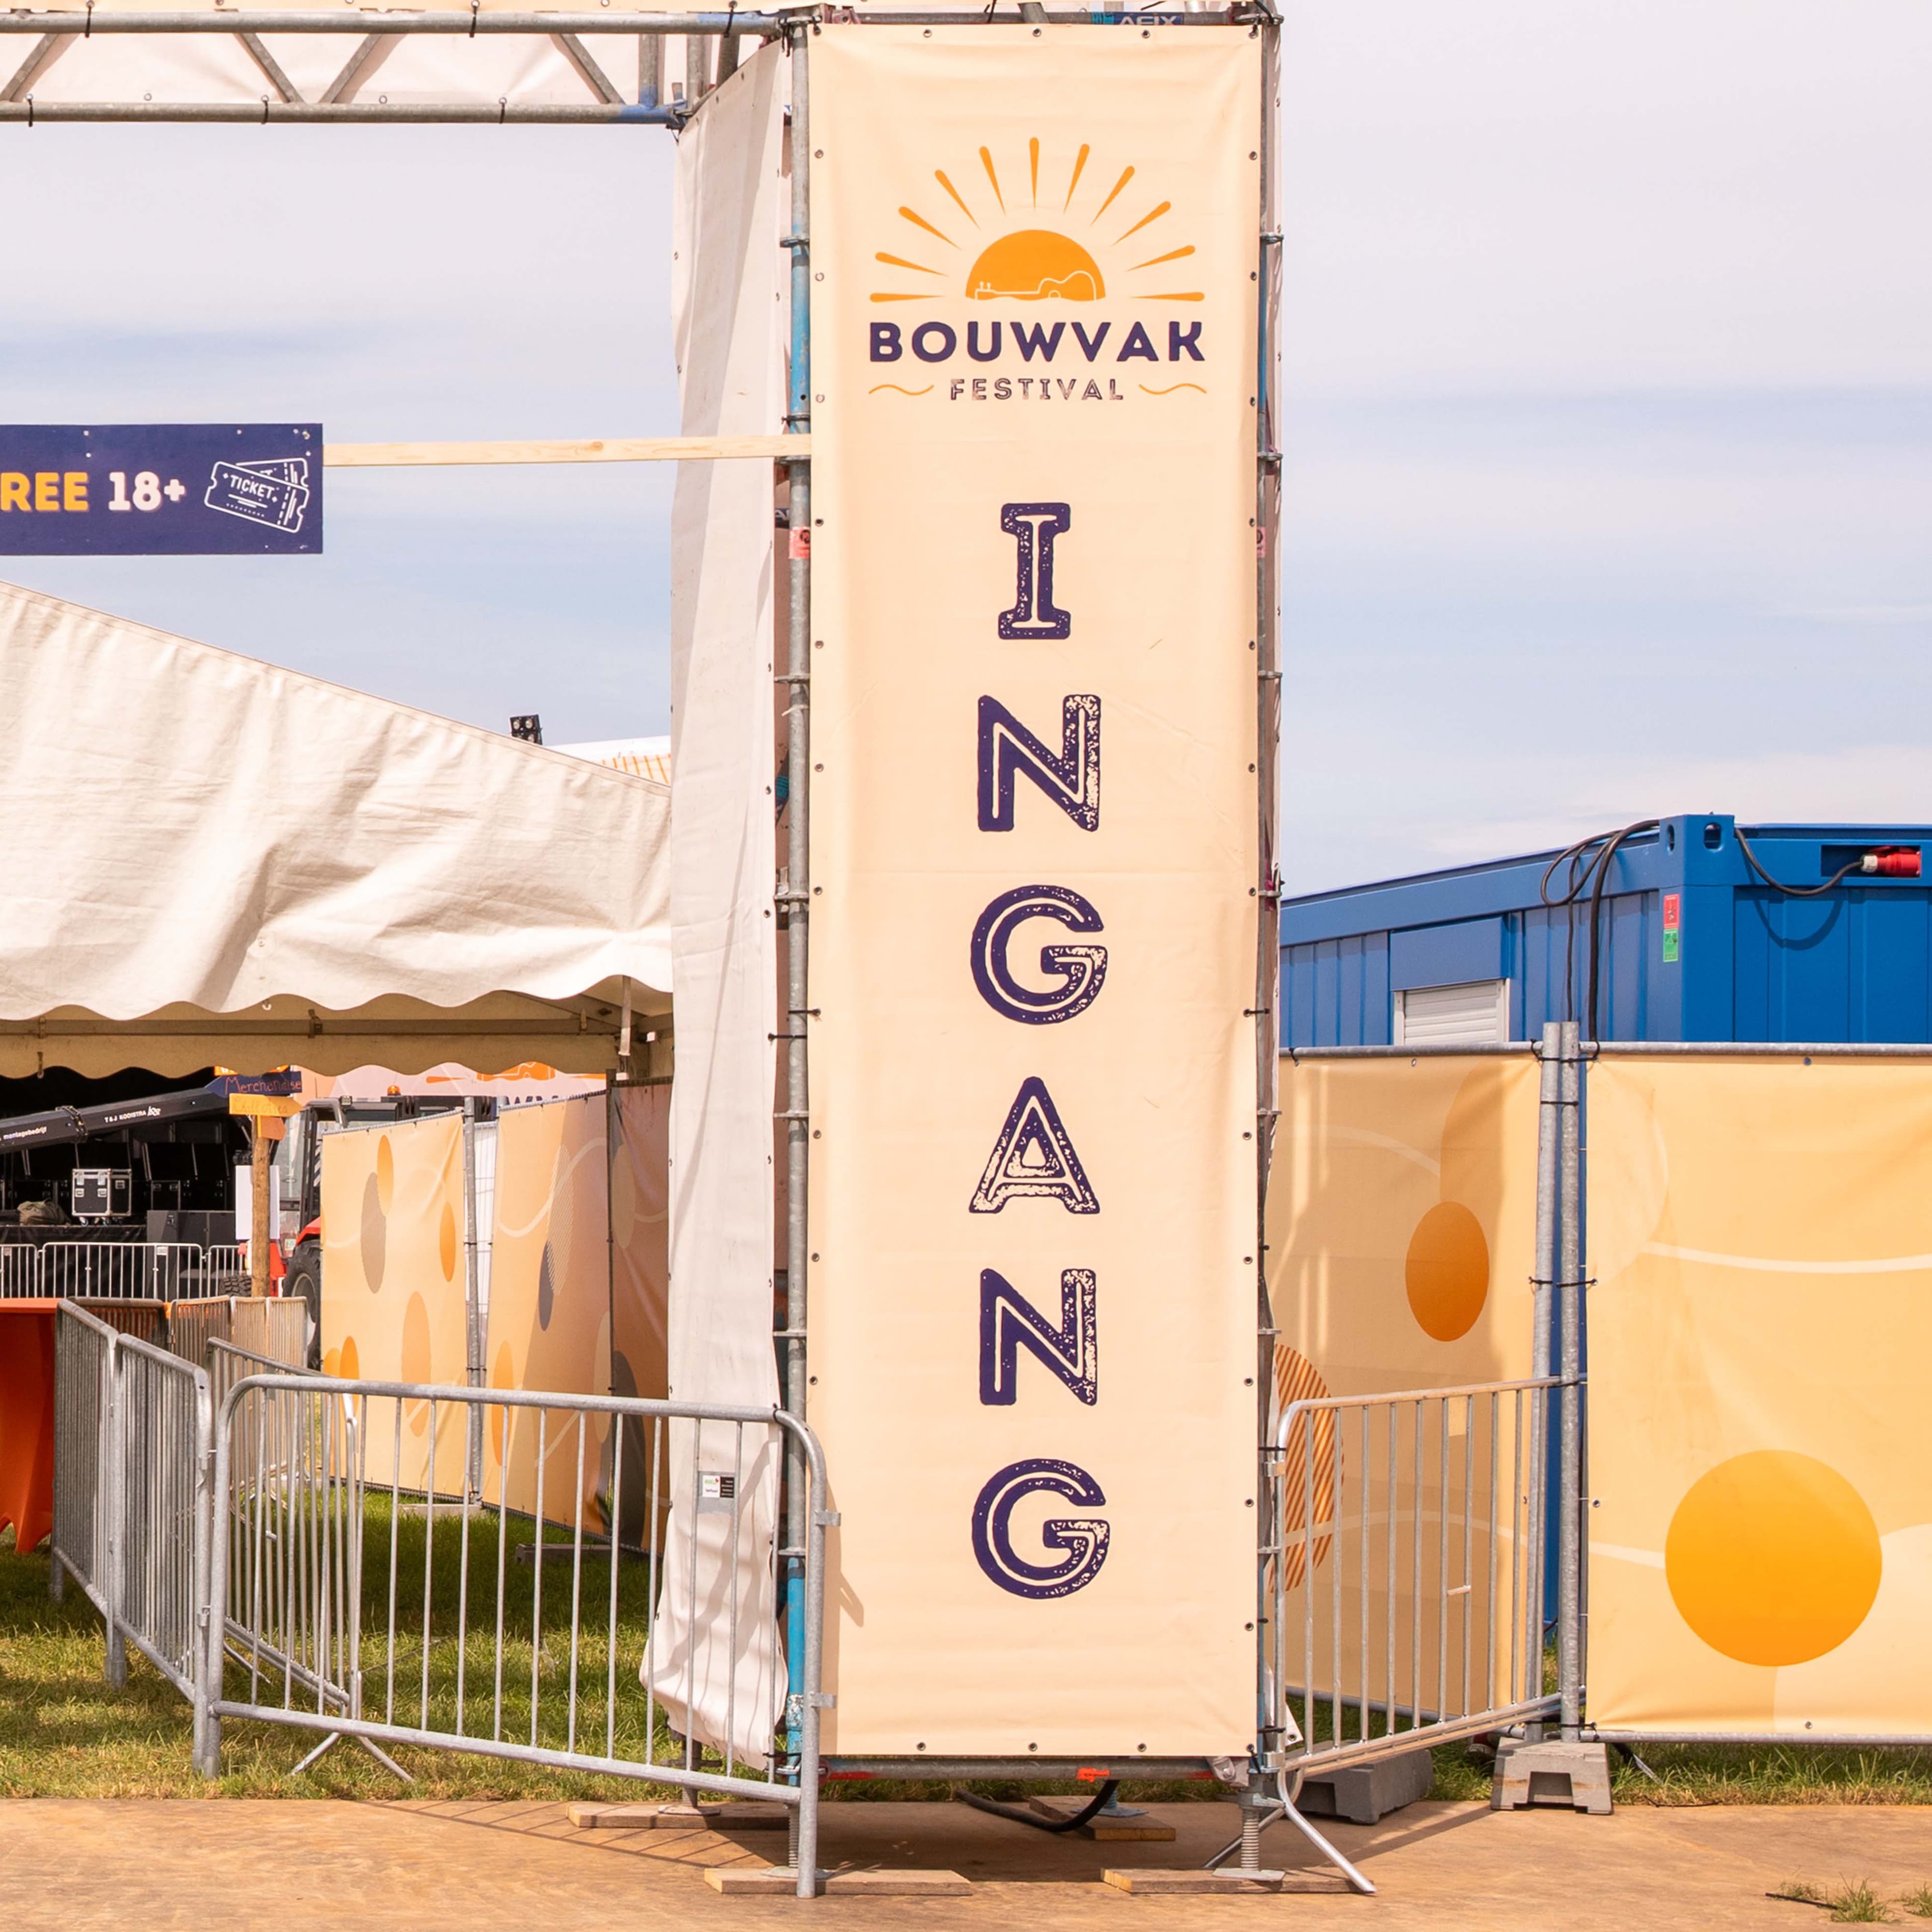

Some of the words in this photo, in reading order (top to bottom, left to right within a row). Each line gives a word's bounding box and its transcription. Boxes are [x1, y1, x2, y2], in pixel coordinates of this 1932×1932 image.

[870, 321, 1205, 362] BOUWVAK
[950, 378, 1123, 400] FESTIVAL
[109, 471, 186, 512] 18+
[230, 474, 275, 499] TICKET
[969, 502, 1110, 1599] INGANG
[225, 1076, 302, 1095] Merchandise
